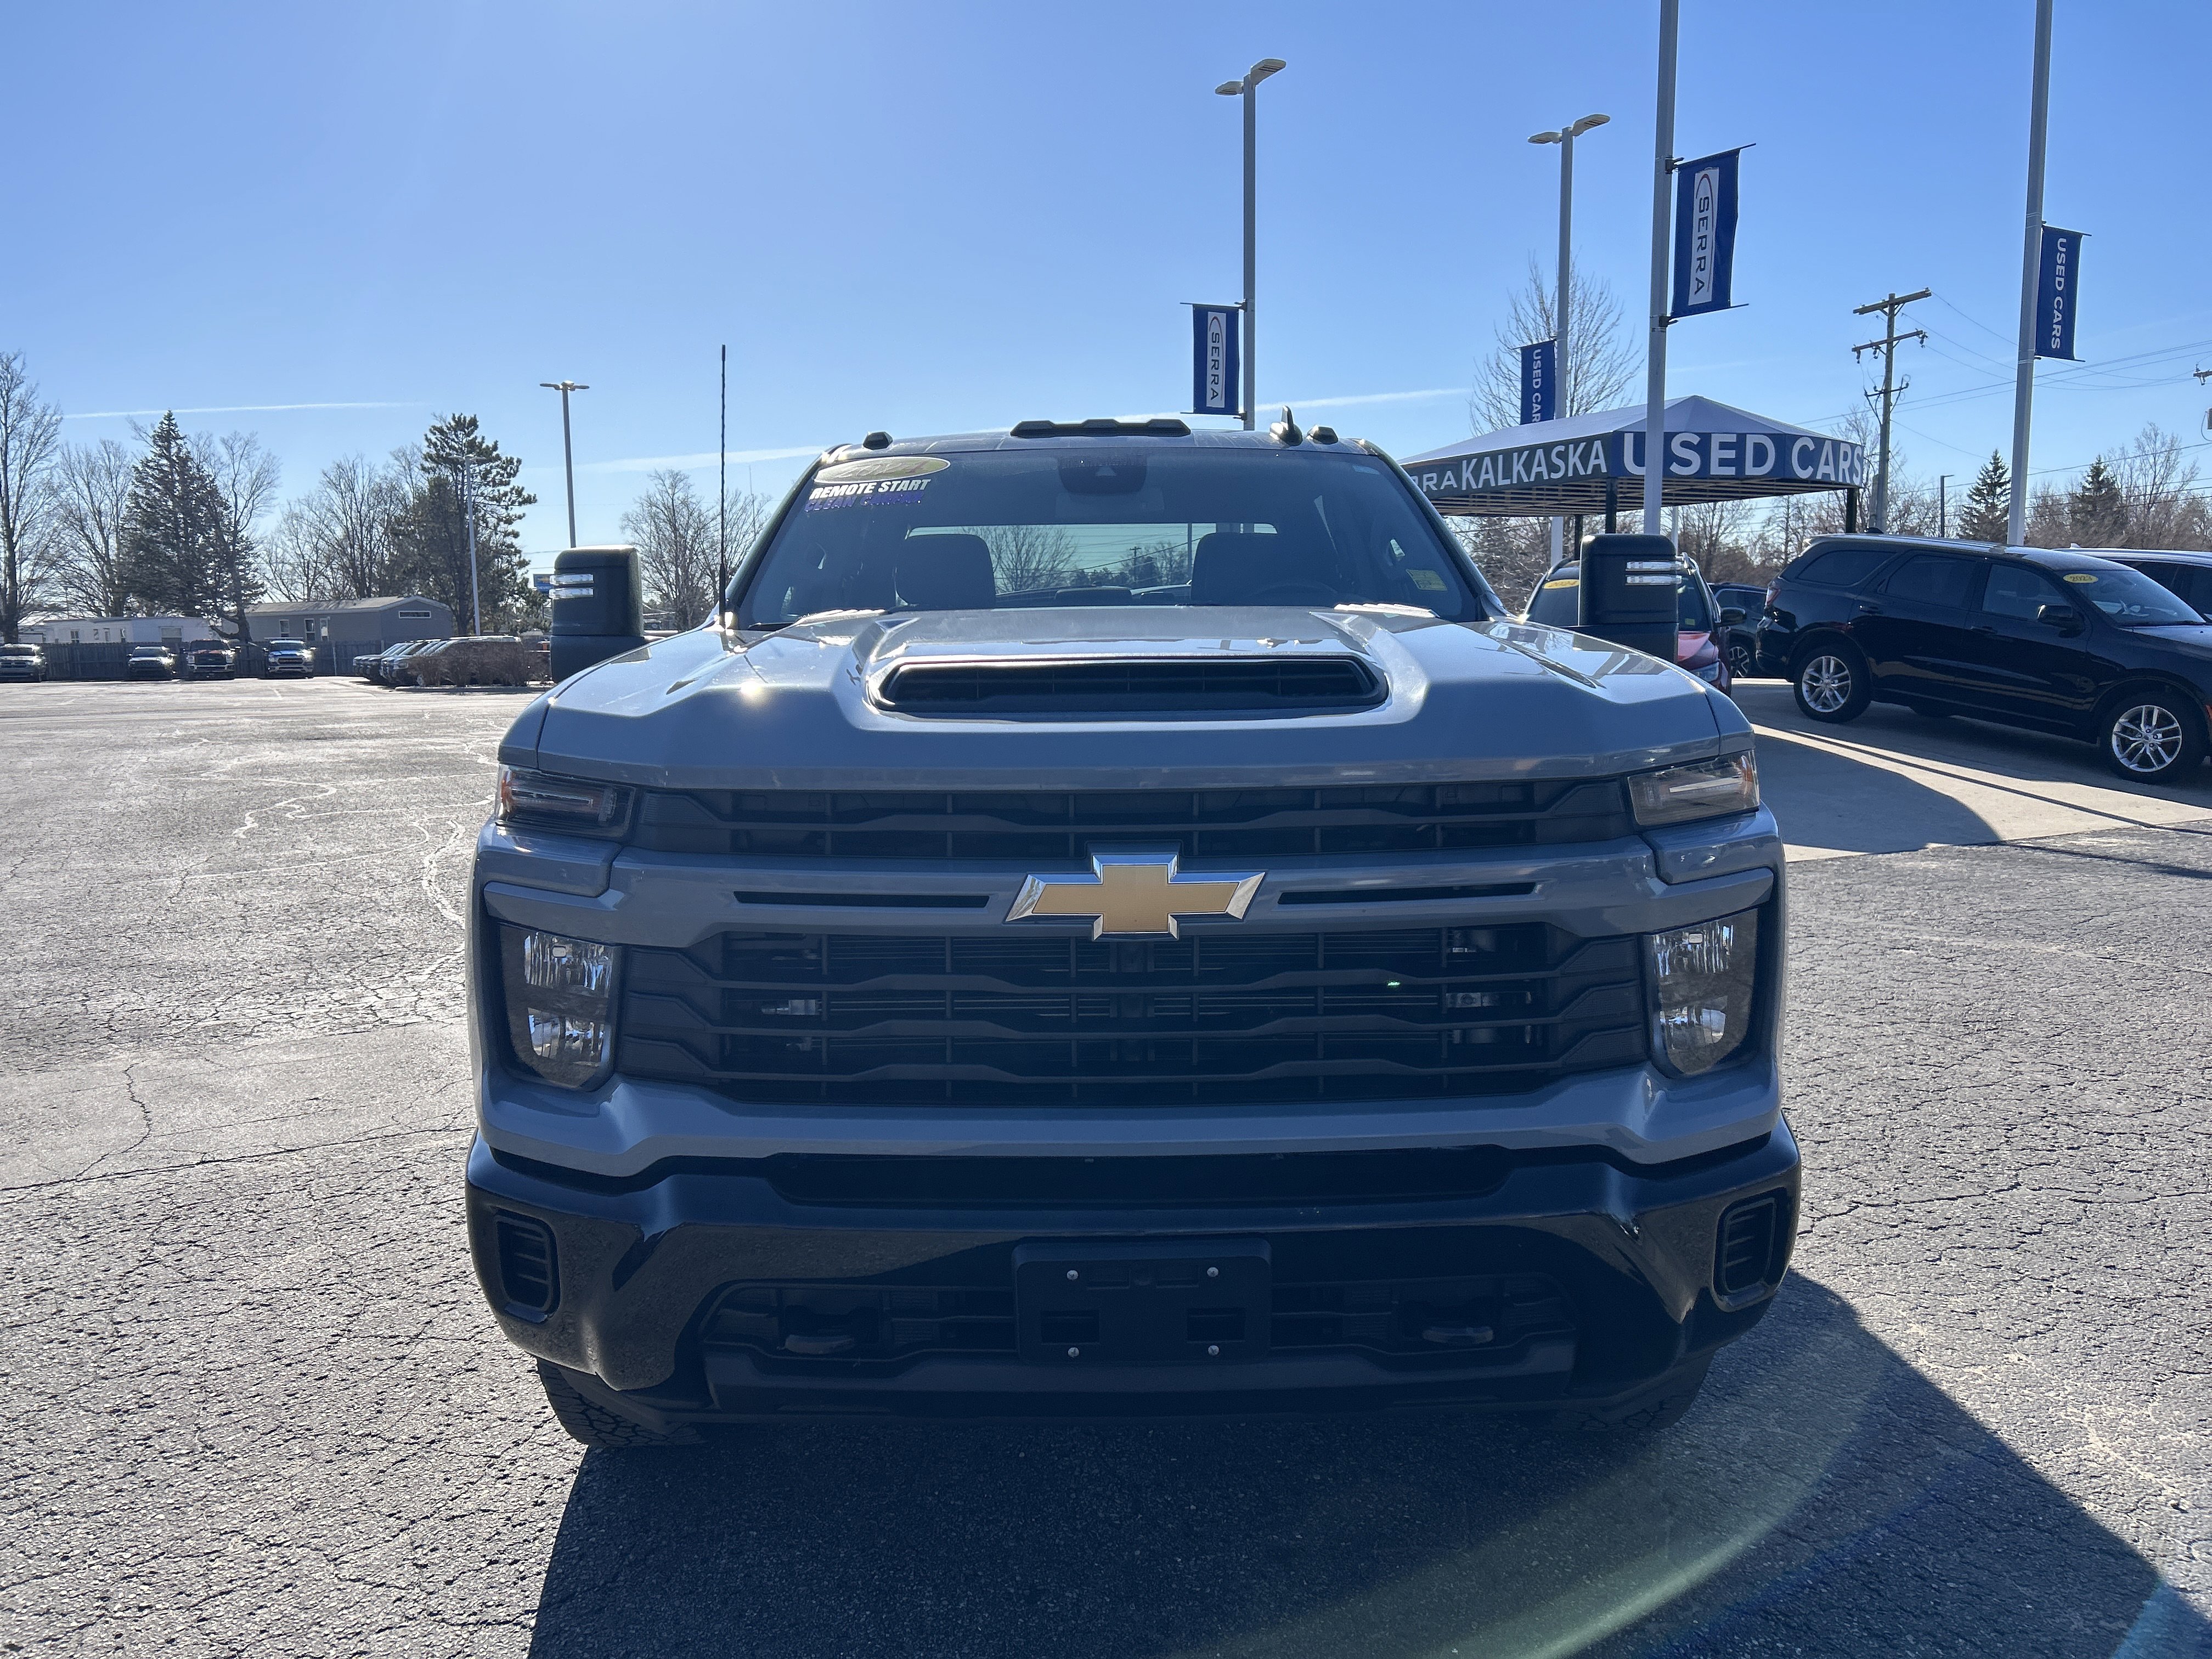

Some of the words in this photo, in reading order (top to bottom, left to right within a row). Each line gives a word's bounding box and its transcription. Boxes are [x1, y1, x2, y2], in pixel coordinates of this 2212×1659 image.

[1694, 196, 1709, 295] SERRA
[2055, 238, 2067, 291] USED
[2051, 296, 2063, 349] CARS
[1210, 331, 1220, 400] SERRA
[1532, 348, 1542, 389] USED
[1462, 439, 1608, 490] KALKASKA
[1624, 433, 1775, 476] USED
[1791, 436, 1863, 487] CARS
[804, 494, 857, 513] CLEAN
[809, 482, 877, 501] REMOTE
[878, 478, 932, 493] START
